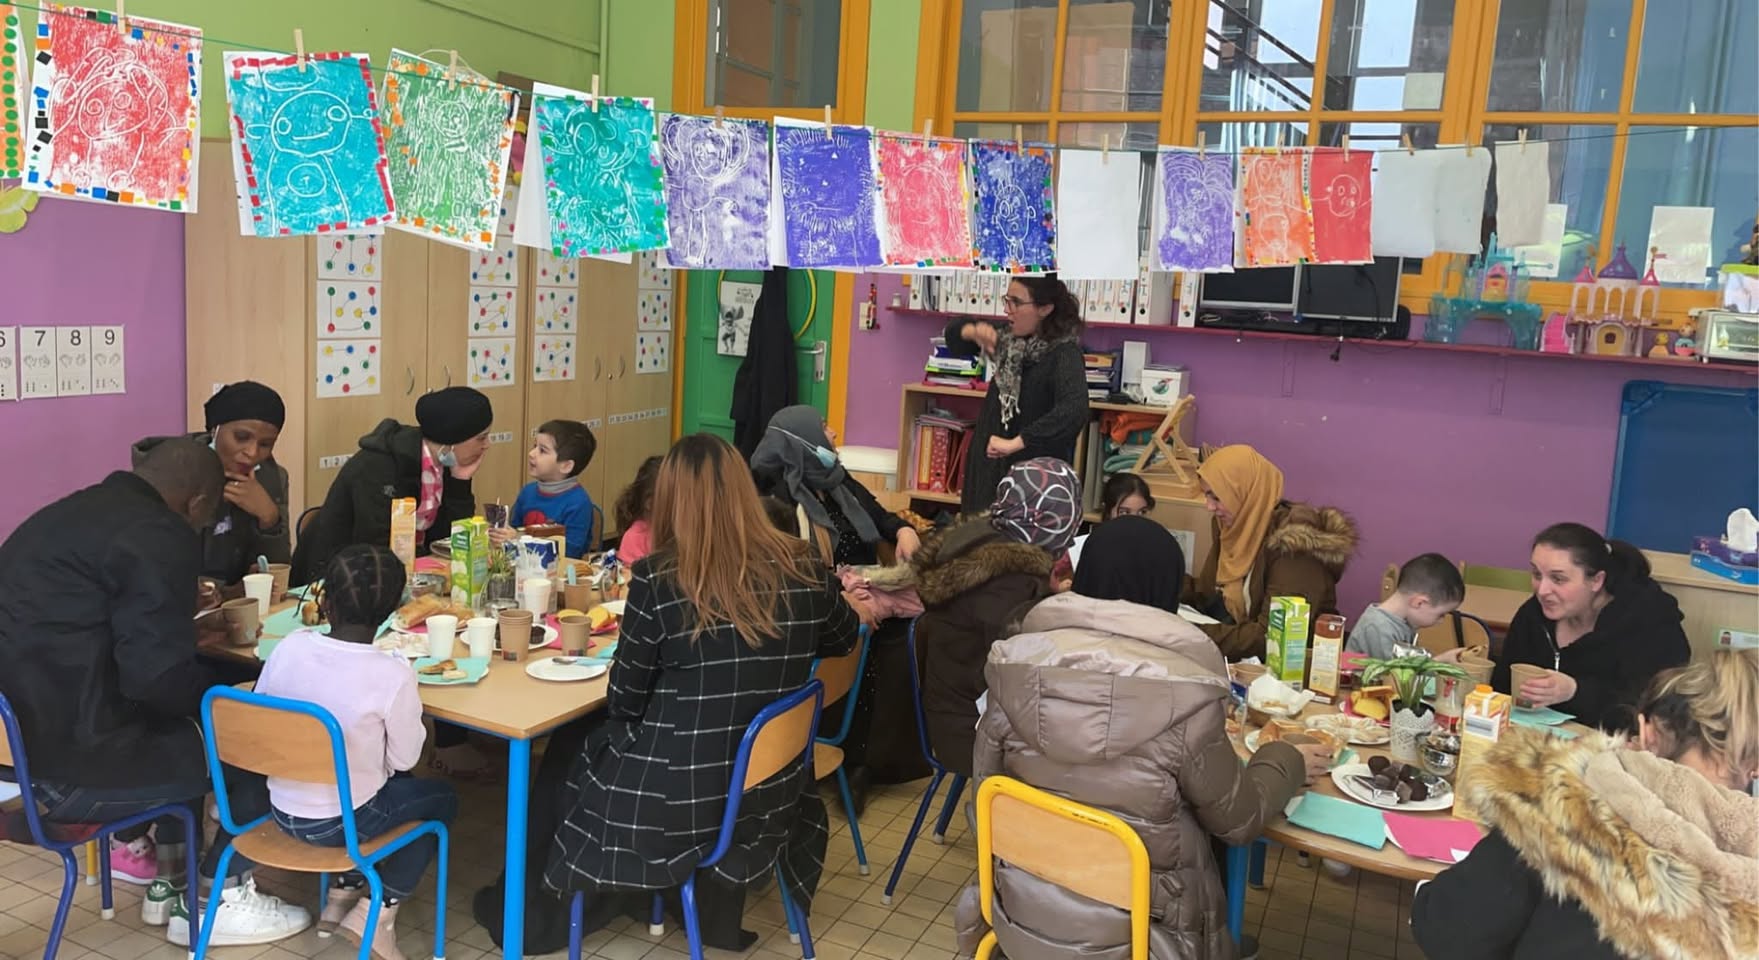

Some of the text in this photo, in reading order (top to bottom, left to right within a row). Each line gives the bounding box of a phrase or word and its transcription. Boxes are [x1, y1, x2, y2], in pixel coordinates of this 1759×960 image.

[0, 329, 115, 347] 6 7 8 9
